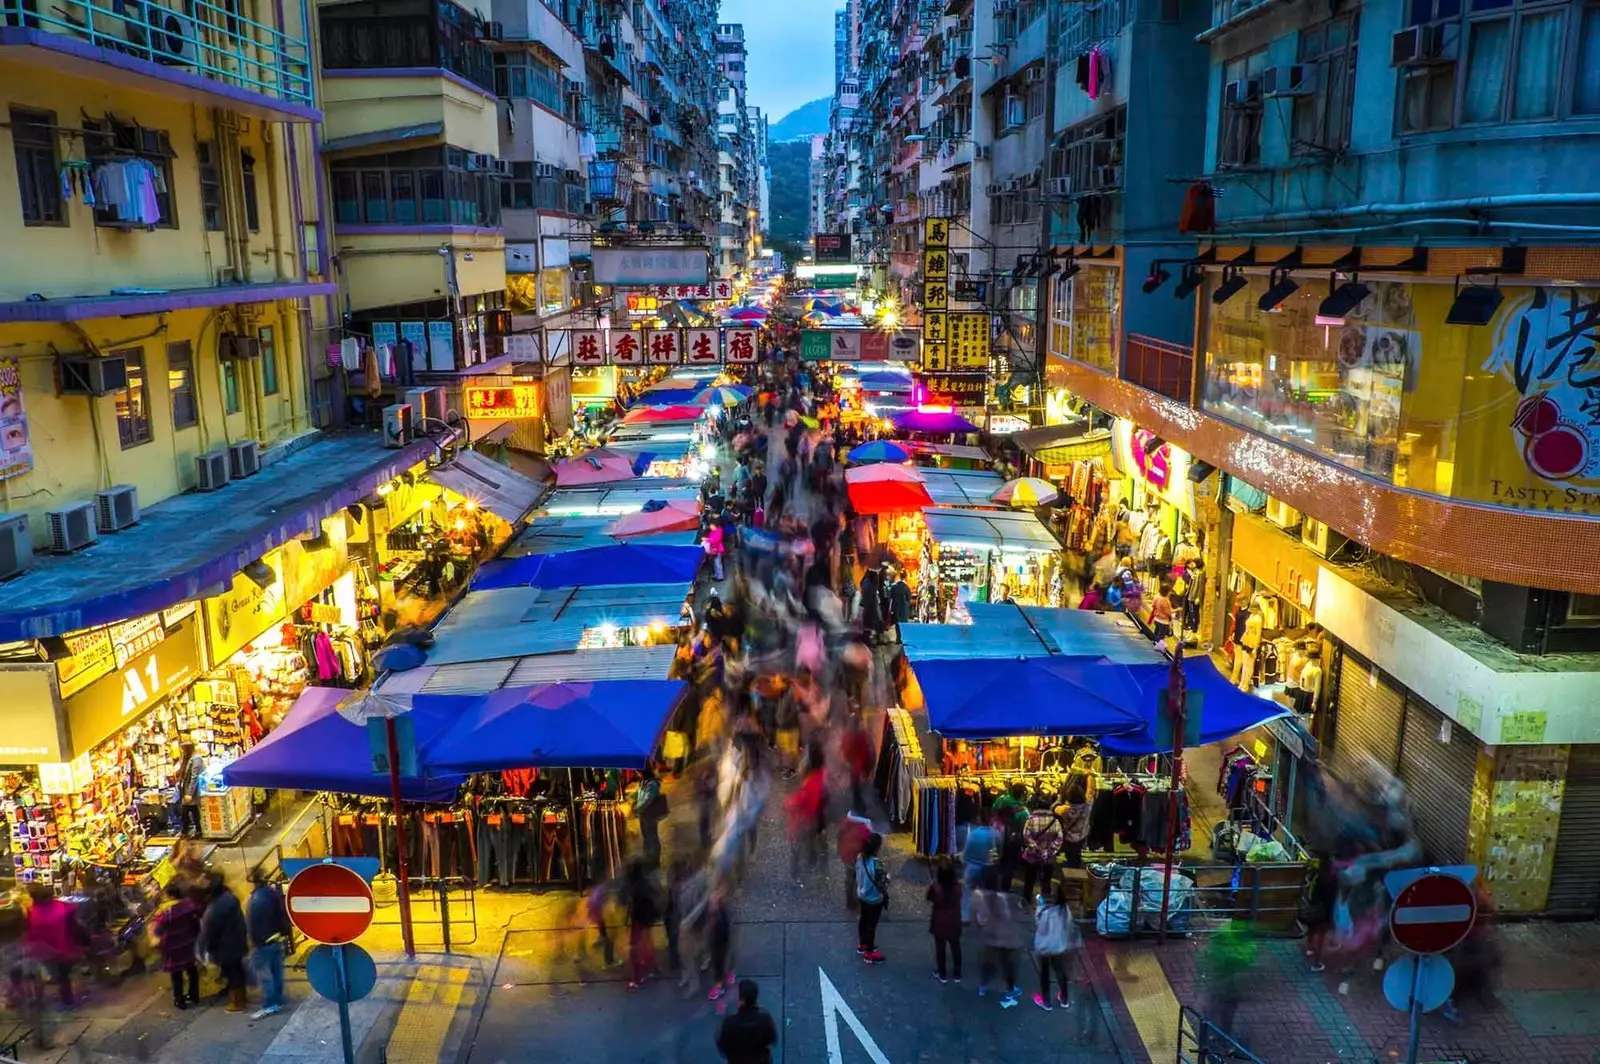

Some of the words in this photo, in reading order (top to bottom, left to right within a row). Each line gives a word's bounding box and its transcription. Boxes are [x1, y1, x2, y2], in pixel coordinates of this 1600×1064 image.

[927, 222, 946, 306] 馬維邦
[121, 654, 161, 717] A1
